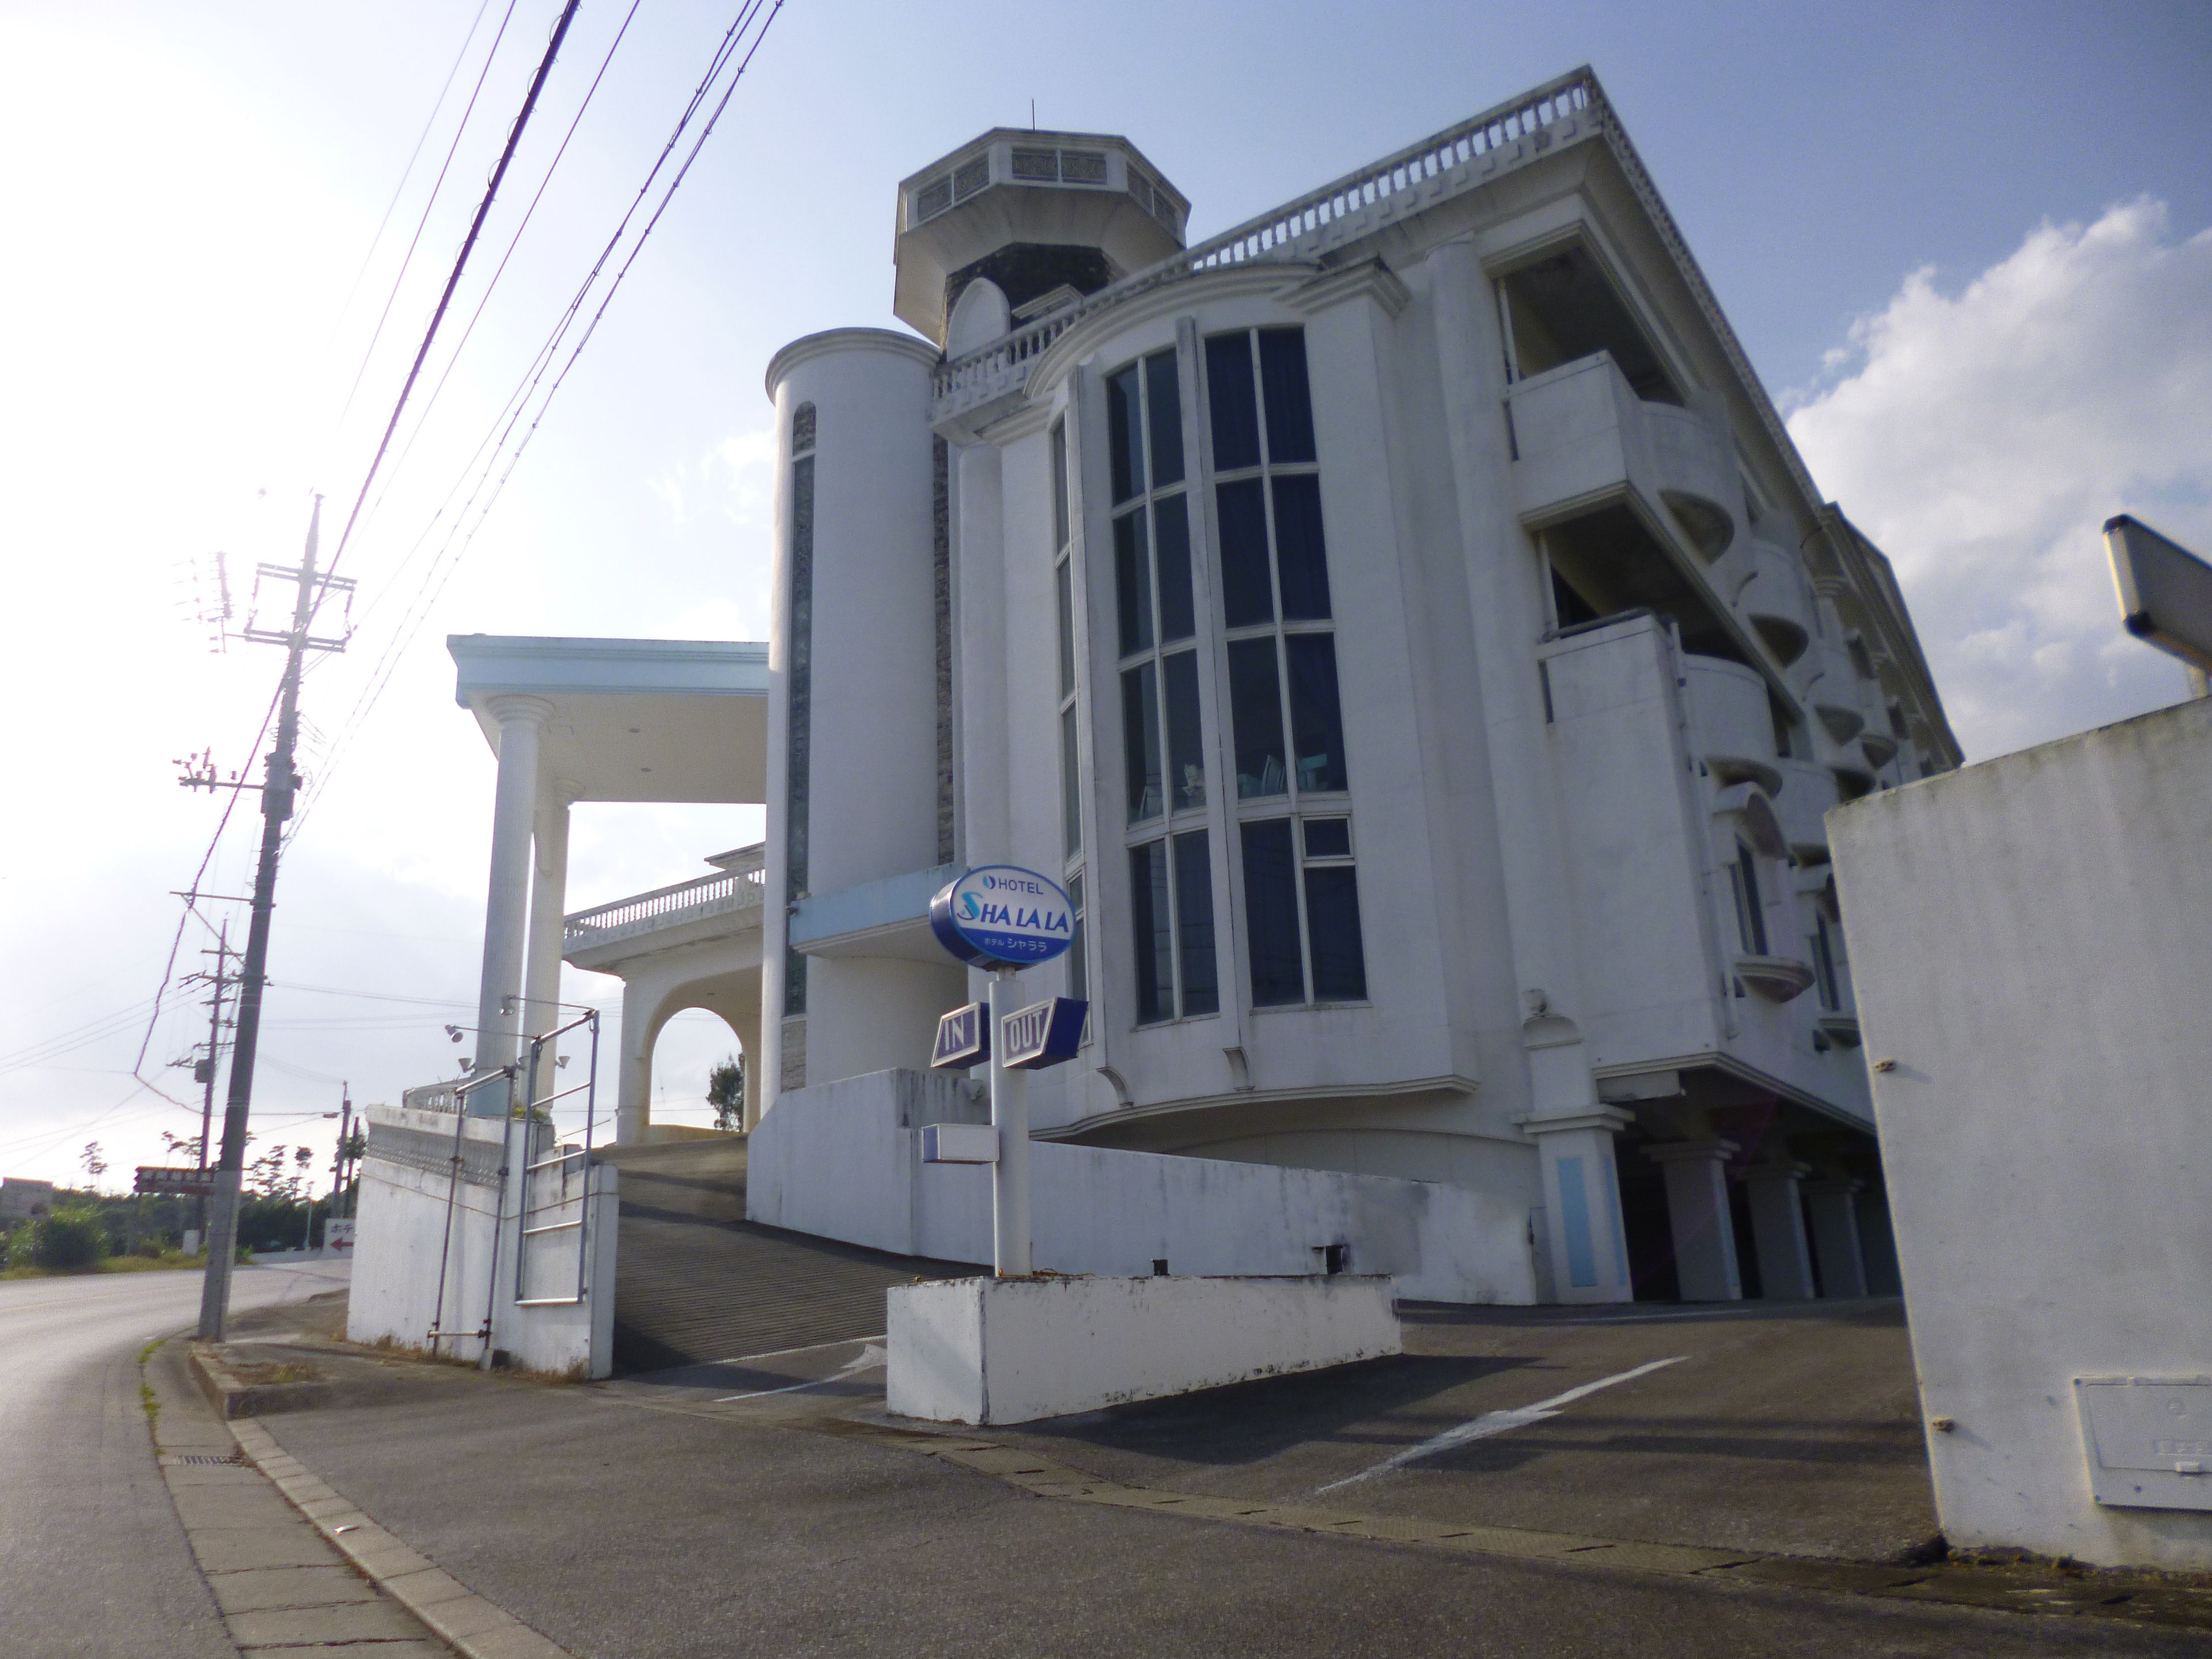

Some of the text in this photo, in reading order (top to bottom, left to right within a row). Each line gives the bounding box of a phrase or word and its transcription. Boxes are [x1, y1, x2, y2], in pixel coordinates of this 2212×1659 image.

[999, 878, 1044, 895] HOTEL
[984, 937, 1047, 952] ホテル シャララ
[945, 1015, 965, 1051] IN
[1010, 1010, 1043, 1053] OUT
[331, 1224, 354, 1233] ホテ
